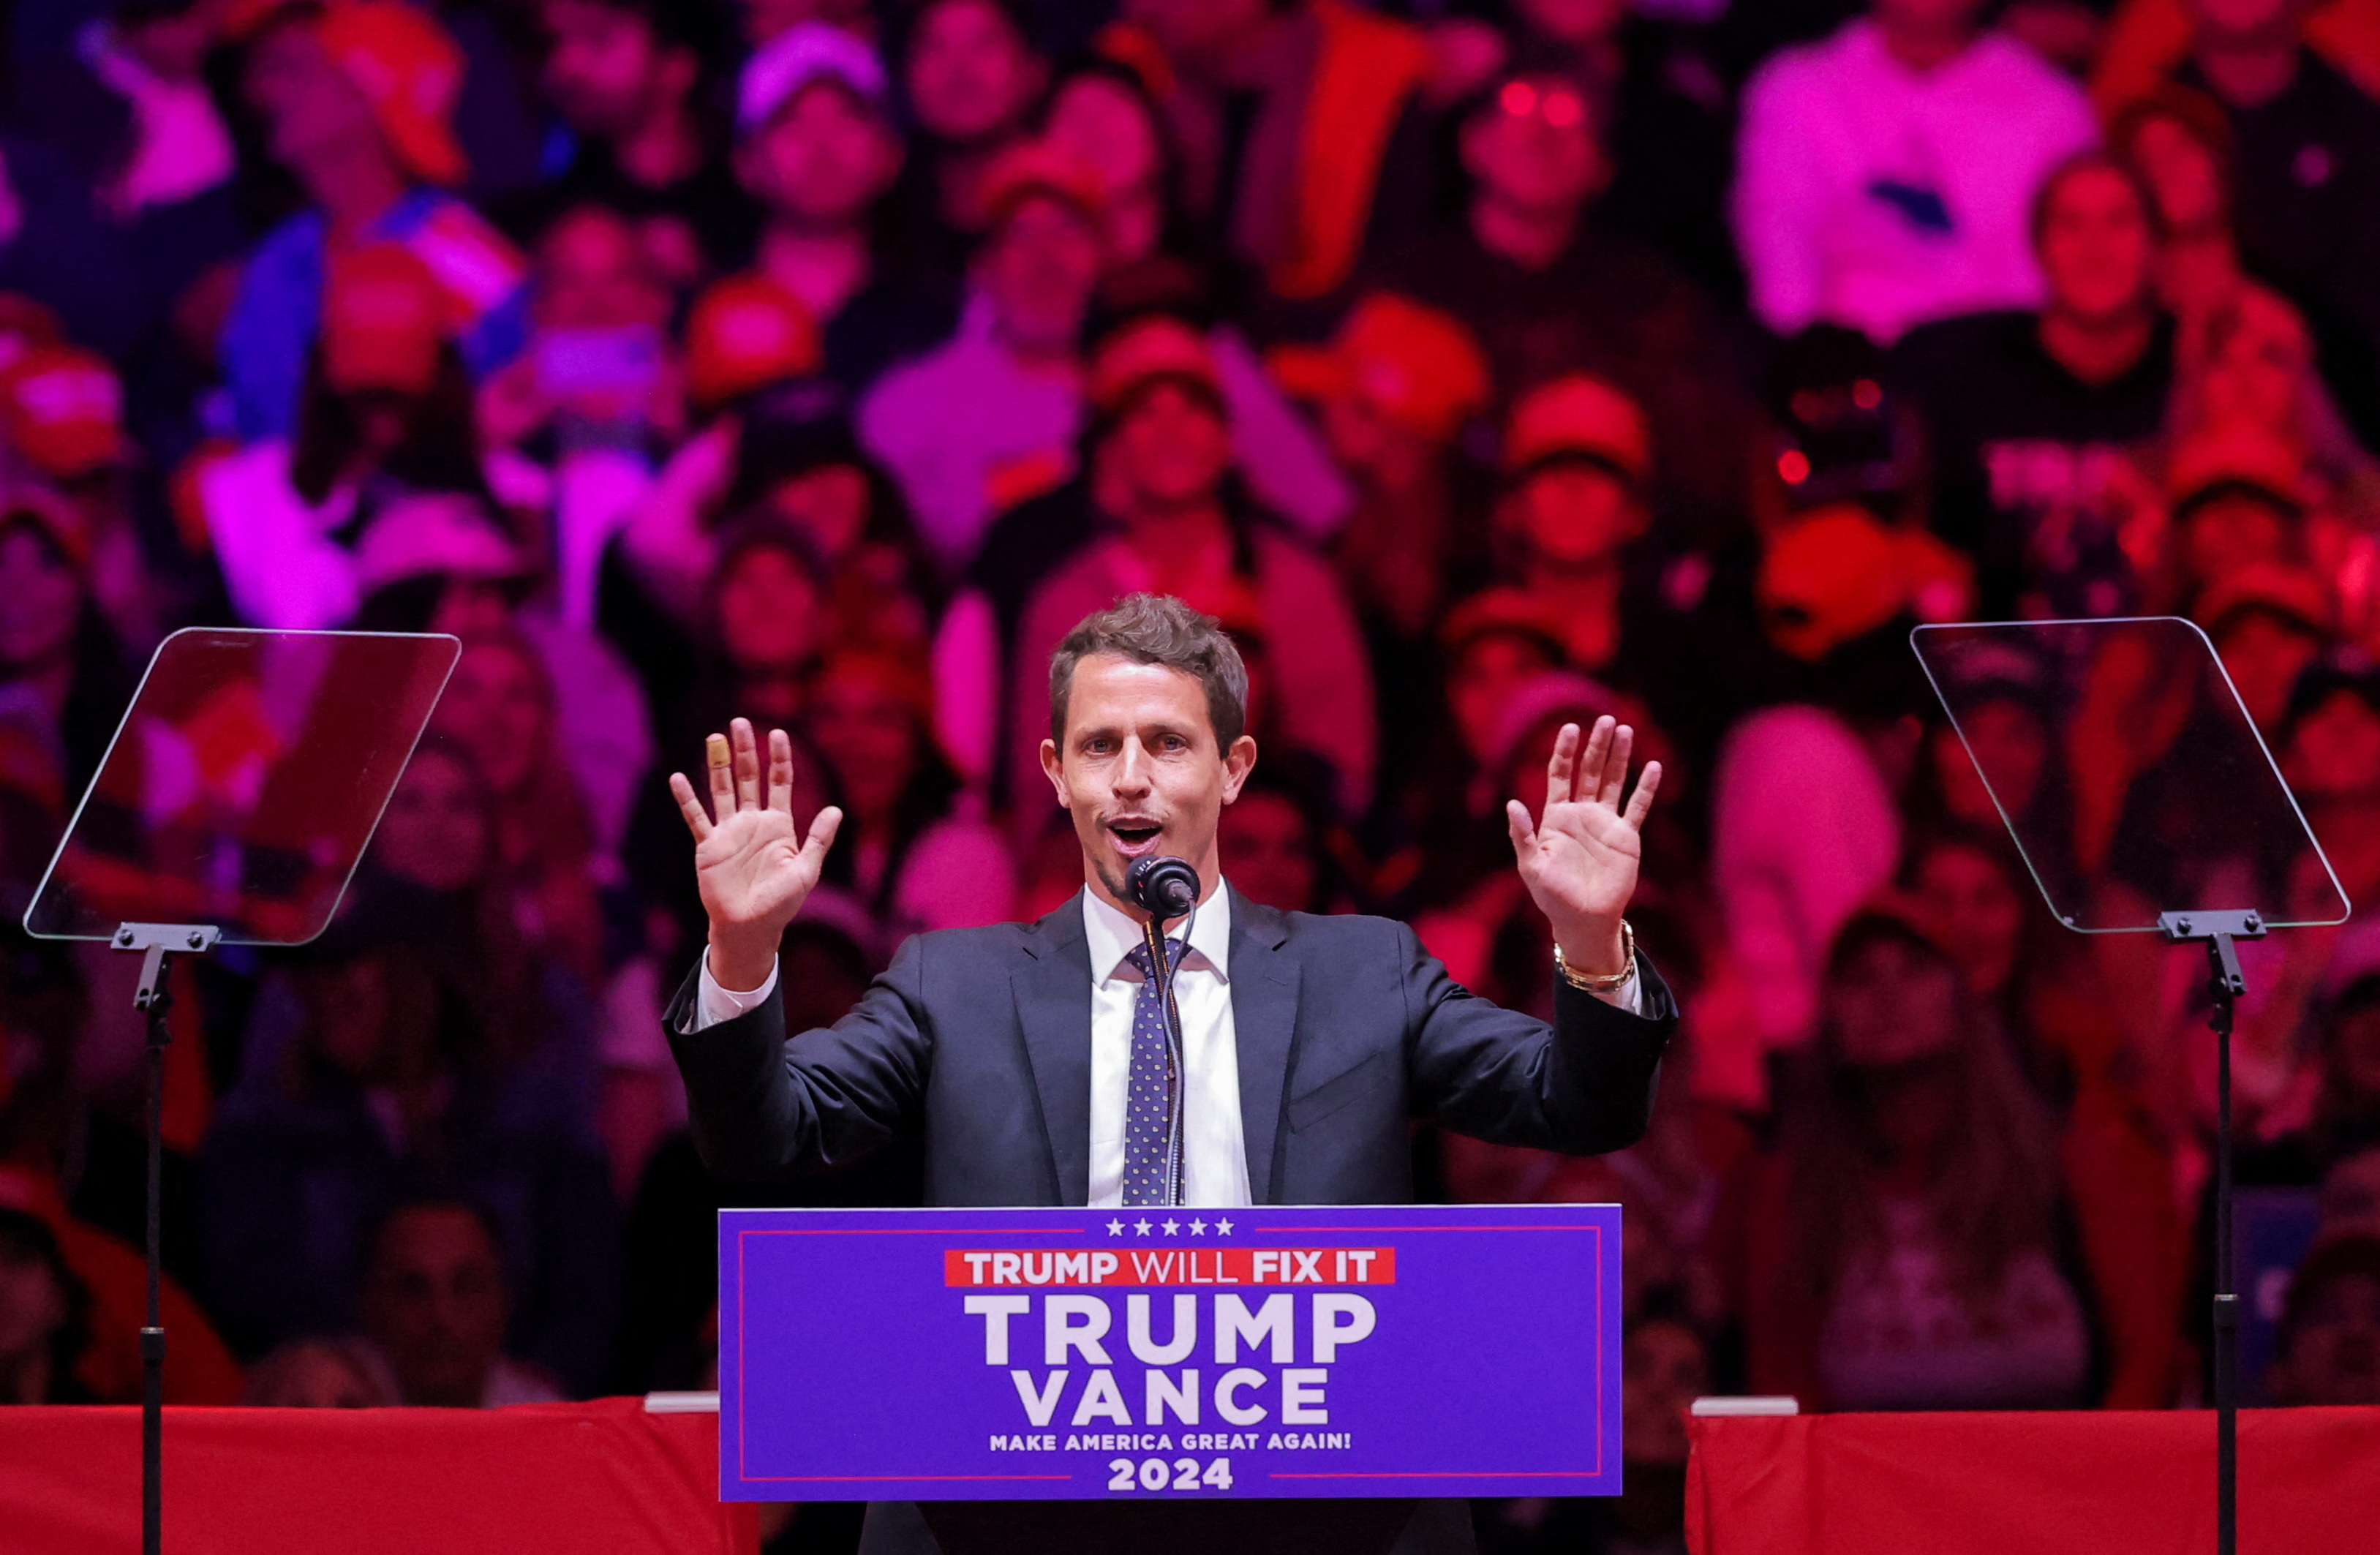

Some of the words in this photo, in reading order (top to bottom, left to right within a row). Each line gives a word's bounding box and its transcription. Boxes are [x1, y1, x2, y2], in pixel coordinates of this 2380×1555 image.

[964, 1252, 1118, 1284] TRUMP
[1130, 1251, 1239, 1284] WILL
[1253, 1251, 1323, 1283] FIX
[1336, 1251, 1376, 1282] IT
[964, 1293, 1376, 1366] TRUMP
[1010, 1368, 1328, 1426] VANCE
[990, 1434, 1056, 1451] MAKE
[1064, 1434, 1173, 1450] AMERICA
[1181, 1433, 1259, 1450] GREAT
[1267, 1433, 1351, 1450] AGAIN!
[1108, 1458, 1233, 1491] 2024
